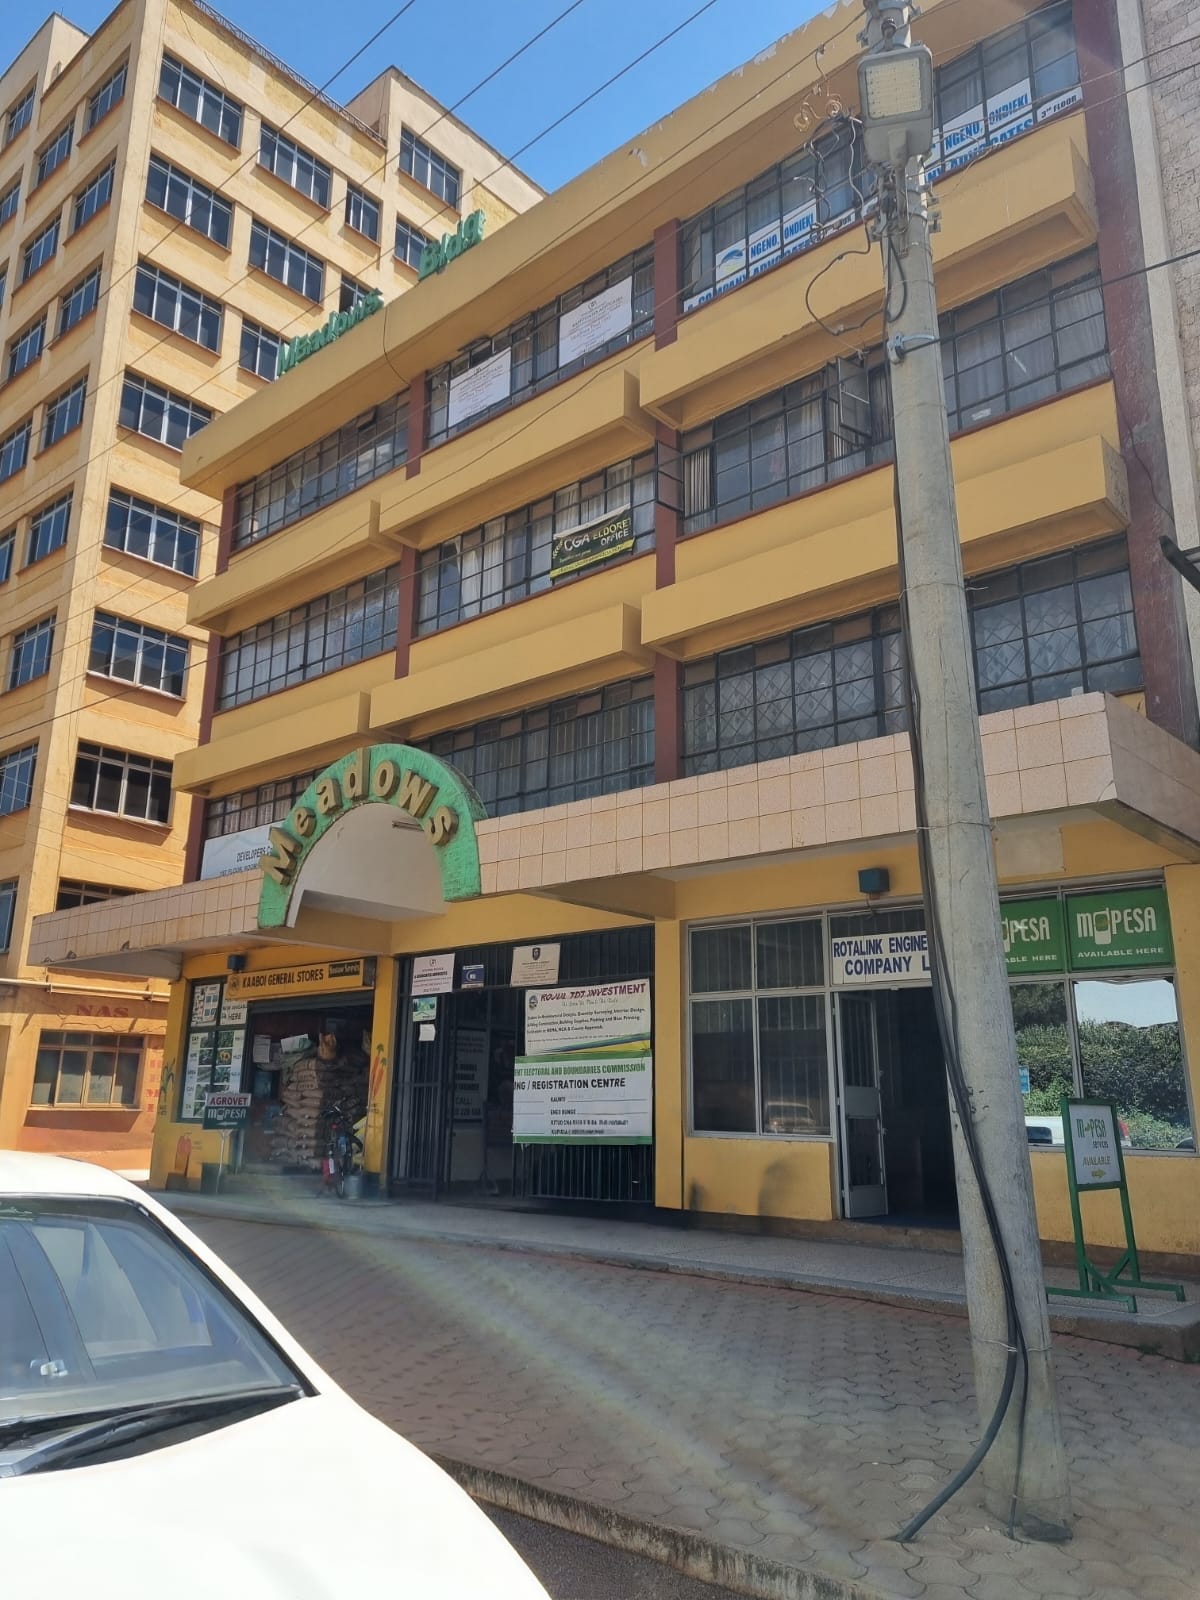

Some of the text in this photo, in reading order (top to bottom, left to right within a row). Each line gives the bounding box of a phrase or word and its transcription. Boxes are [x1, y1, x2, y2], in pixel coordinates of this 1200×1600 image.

[988, 92, 1029, 125] ONDIEKI
[1053, 94, 1077, 113] FLOOR
[784, 213, 814, 239] ONDIEKI
[564, 533, 590, 552] CGA
[601, 528, 629, 546] OFFICE
[260, 746, 460, 887] Meadows
[236, 846, 266, 863] DEVELOPERS
[833, 934, 928, 958] ROTALINK ENGINE
[1077, 946, 1165, 960] AVAILABLE HERE
[844, 954, 931, 976] COMPANY L
[1032, 954, 1058, 963] HERE
[268, 972, 295, 986] GENERAL
[297, 968, 324, 983] STORES
[587, 983, 646, 997] INVESTMENT
[524, 1067, 550, 1076] ELECTORAL
[551, 1066, 562, 1076] AND
[563, 1065, 600, 1075] BOUNDARIES
[602, 1063, 646, 1074] COMMISSION
[532, 1079, 589, 1090] REGISTRATION
[590, 1077, 626, 1089] CENTRE
[210, 1096, 249, 1106] AGROVET
[1082, 1155, 1111, 1167] AVAILABLE
